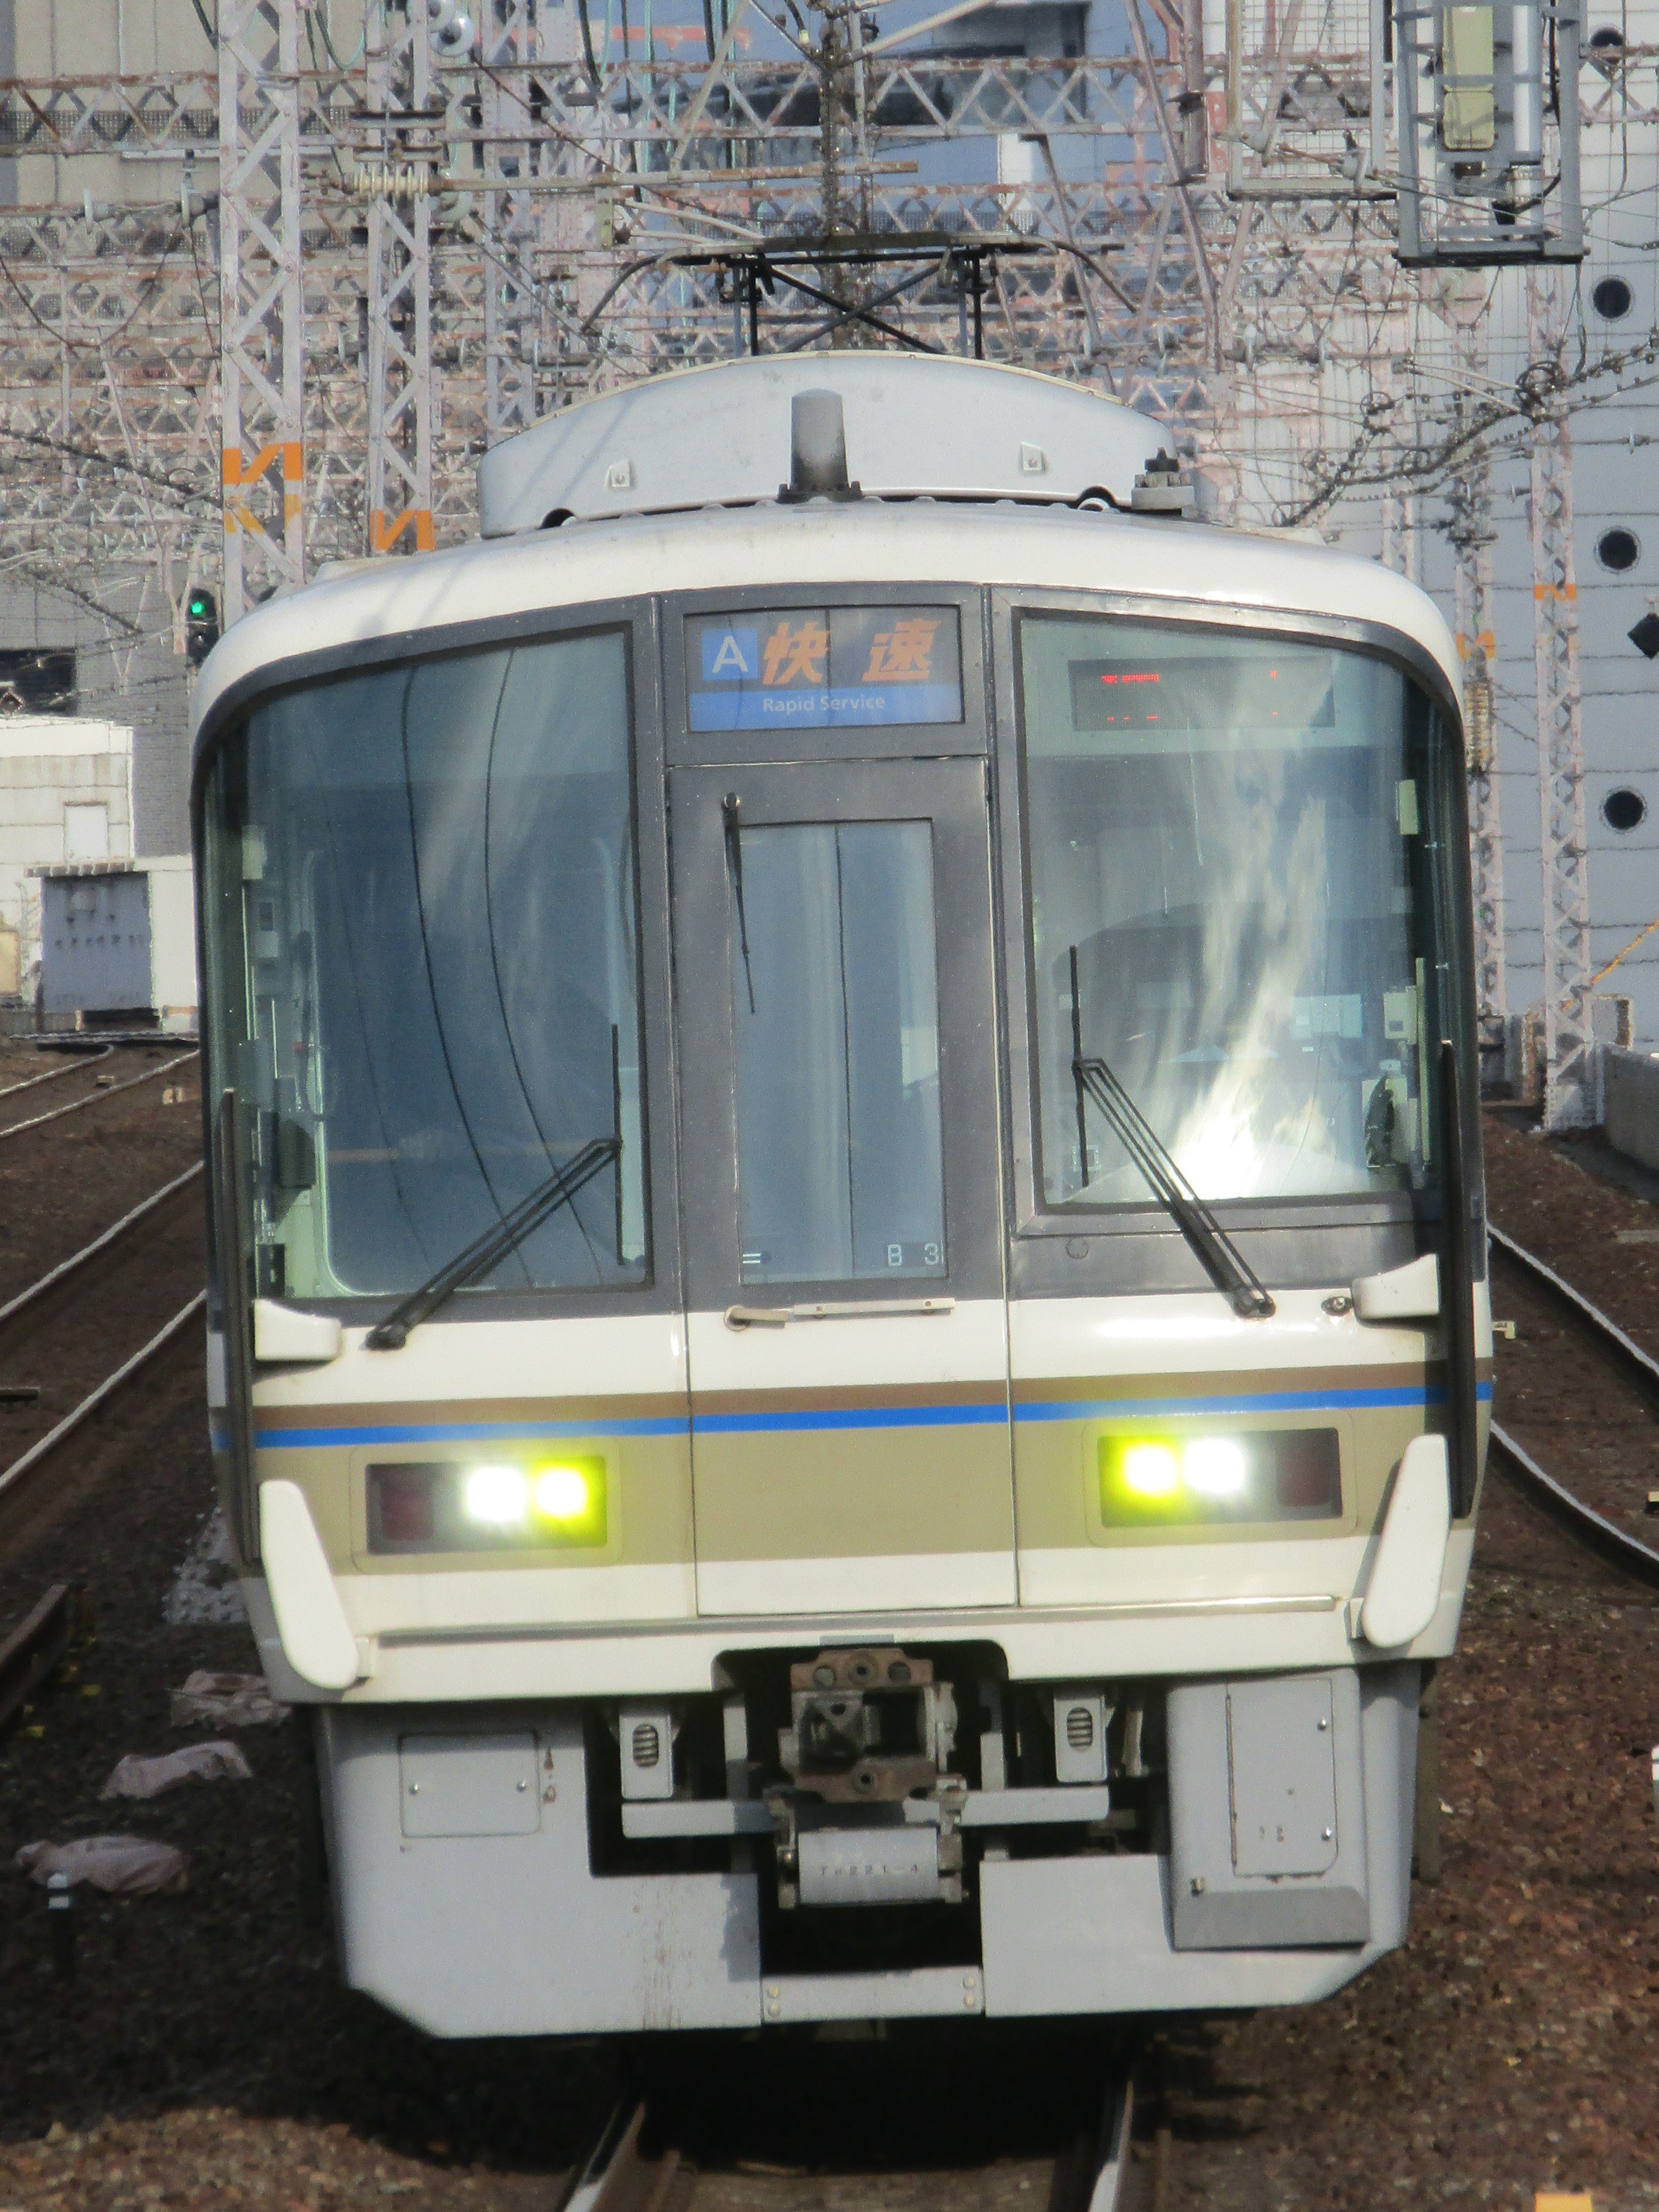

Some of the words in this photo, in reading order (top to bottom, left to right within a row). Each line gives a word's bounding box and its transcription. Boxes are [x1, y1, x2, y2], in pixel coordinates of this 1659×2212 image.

[711, 635, 748, 673] A
[762, 619, 941, 686] 快速
[763, 695, 814, 715] Rapid
[819, 694, 886, 712] Service
